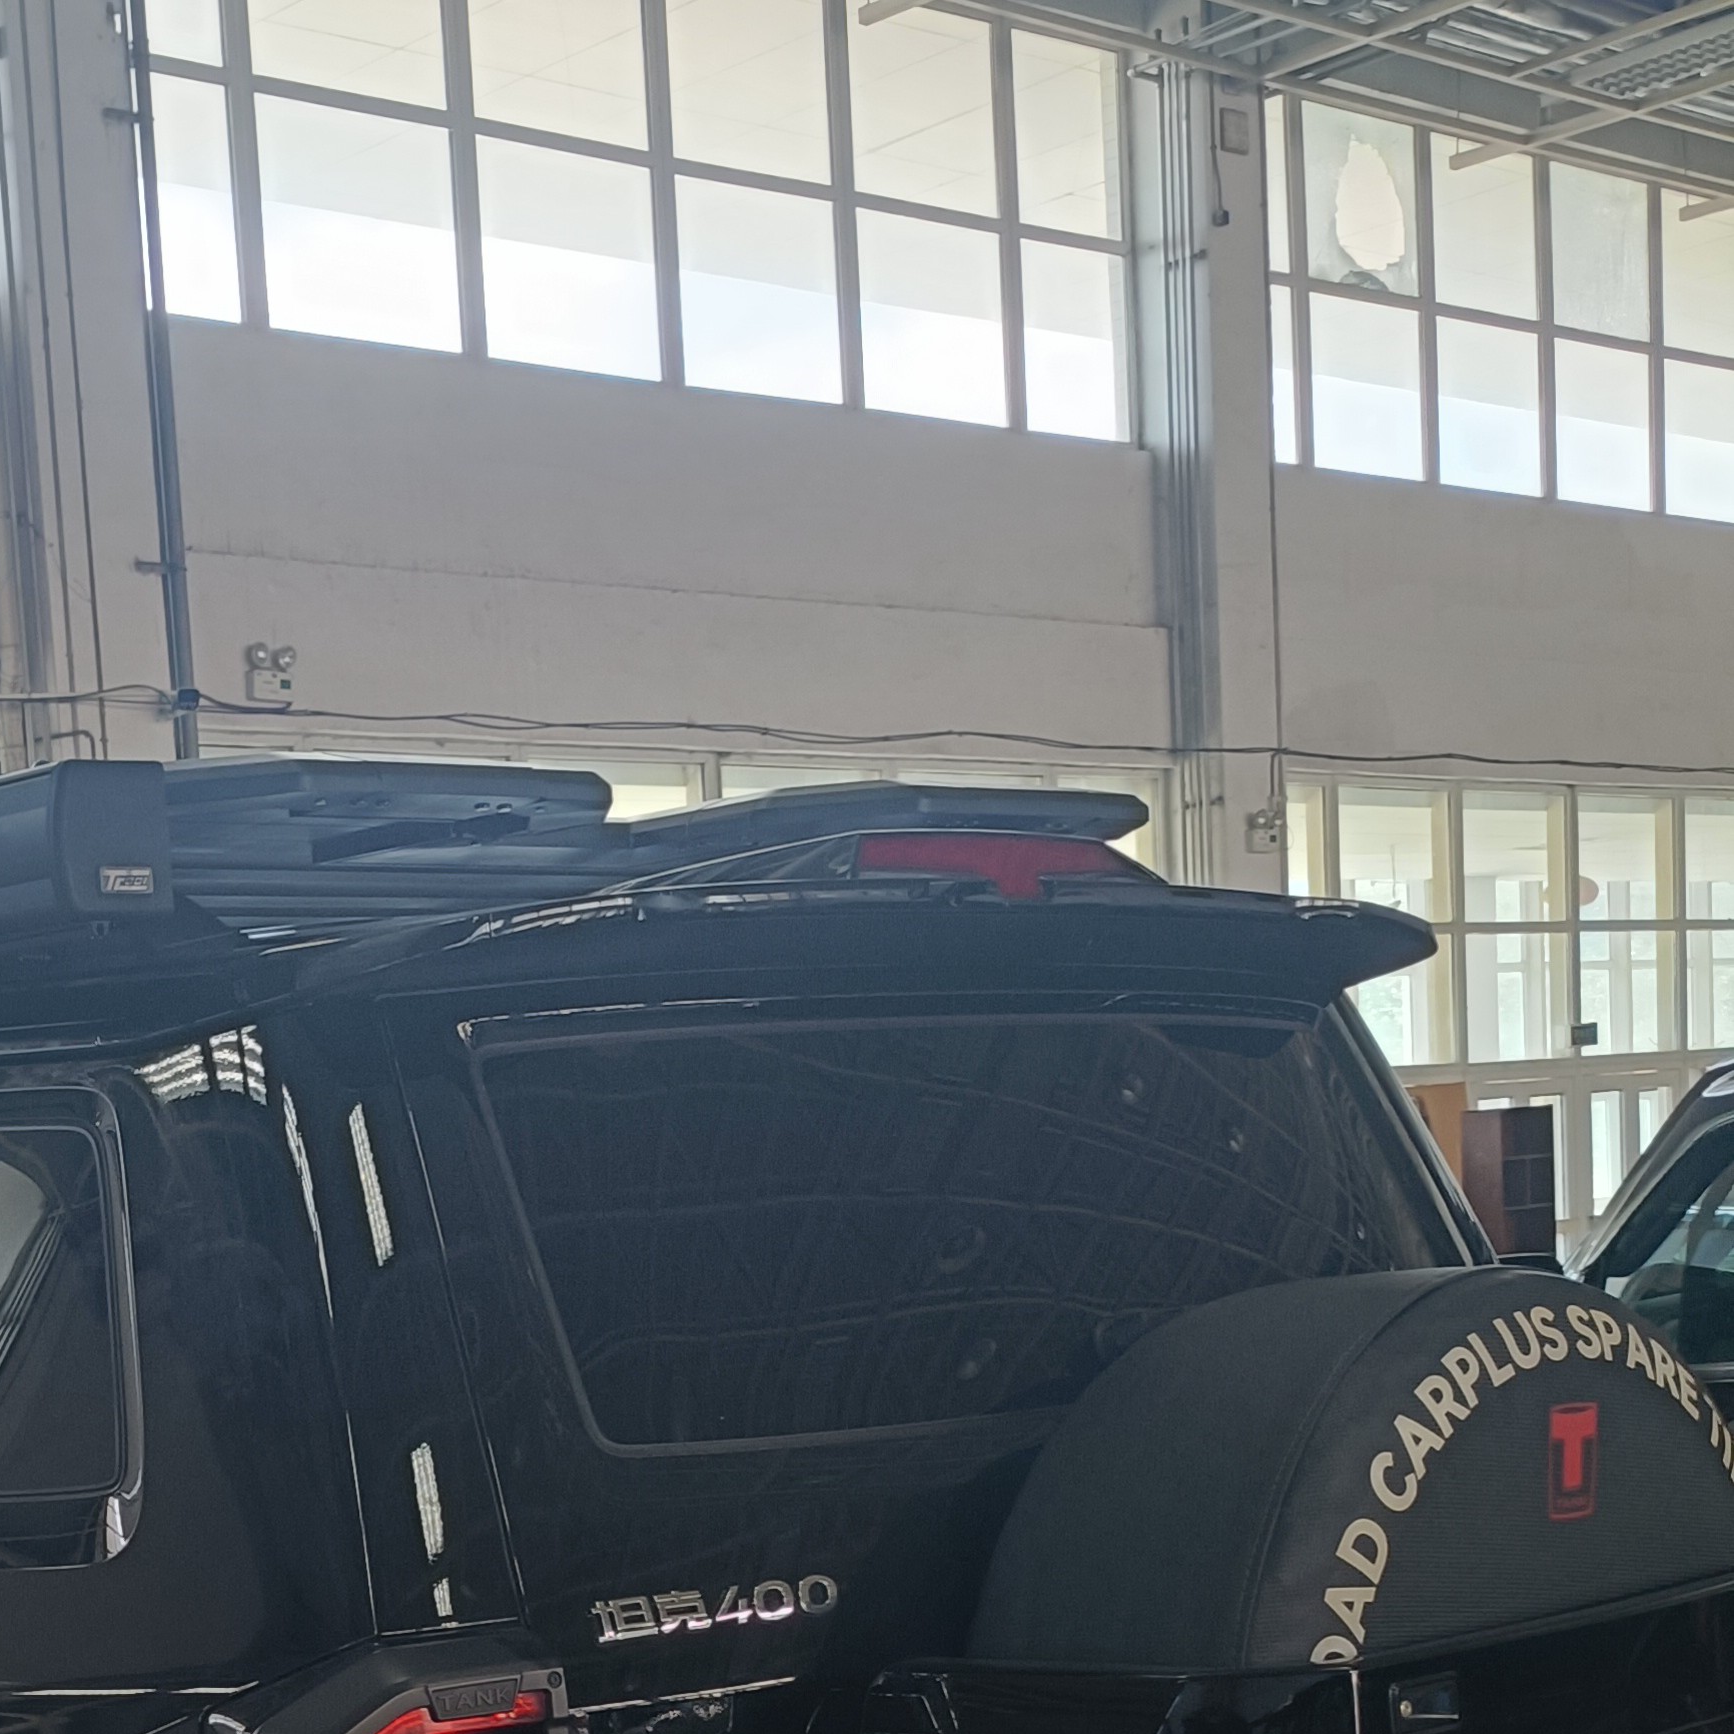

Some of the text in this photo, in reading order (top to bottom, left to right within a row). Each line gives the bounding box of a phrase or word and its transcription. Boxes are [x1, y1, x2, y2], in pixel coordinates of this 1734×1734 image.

[1370, 1305, 1569, 1512] CARPLUS
[1565, 1304, 1701, 1422] SPARE
[1703, 1392, 1734, 1483] TI
[588, 1574, 838, 1644] 坦克400
[438, 1687, 512, 1712] TANK
